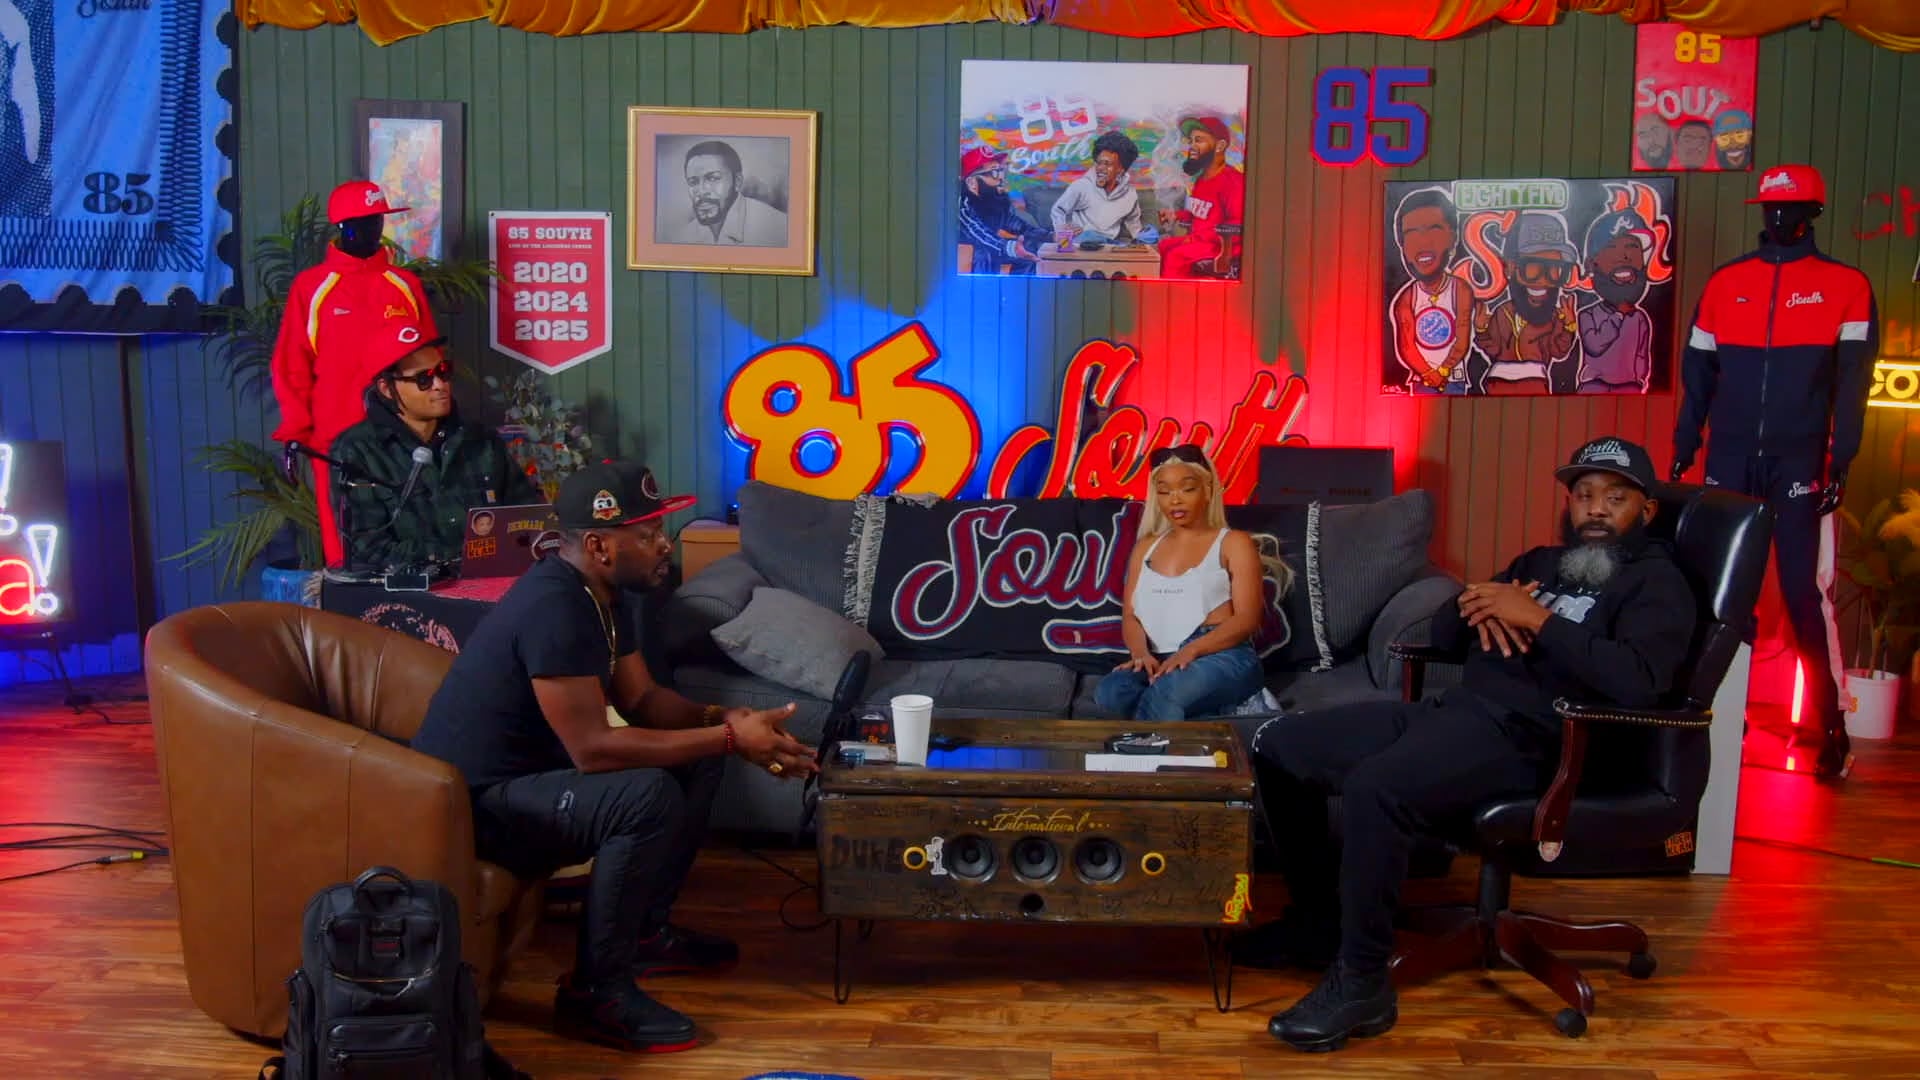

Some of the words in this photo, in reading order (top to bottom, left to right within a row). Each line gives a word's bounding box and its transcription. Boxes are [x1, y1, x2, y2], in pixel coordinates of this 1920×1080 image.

[1675, 31, 1722, 64] 85
[1310, 66, 1433, 167] 85
[83, 171, 154, 216] 85
[508, 226, 529, 240] 85
[535, 227, 593, 240] SOUTH
[514, 261, 588, 284] 2020
[514, 290, 589, 313] 2024
[514, 319, 589, 341] 2025
[719, 320, 983, 502] 85
[988, 808, 1091, 832] International
